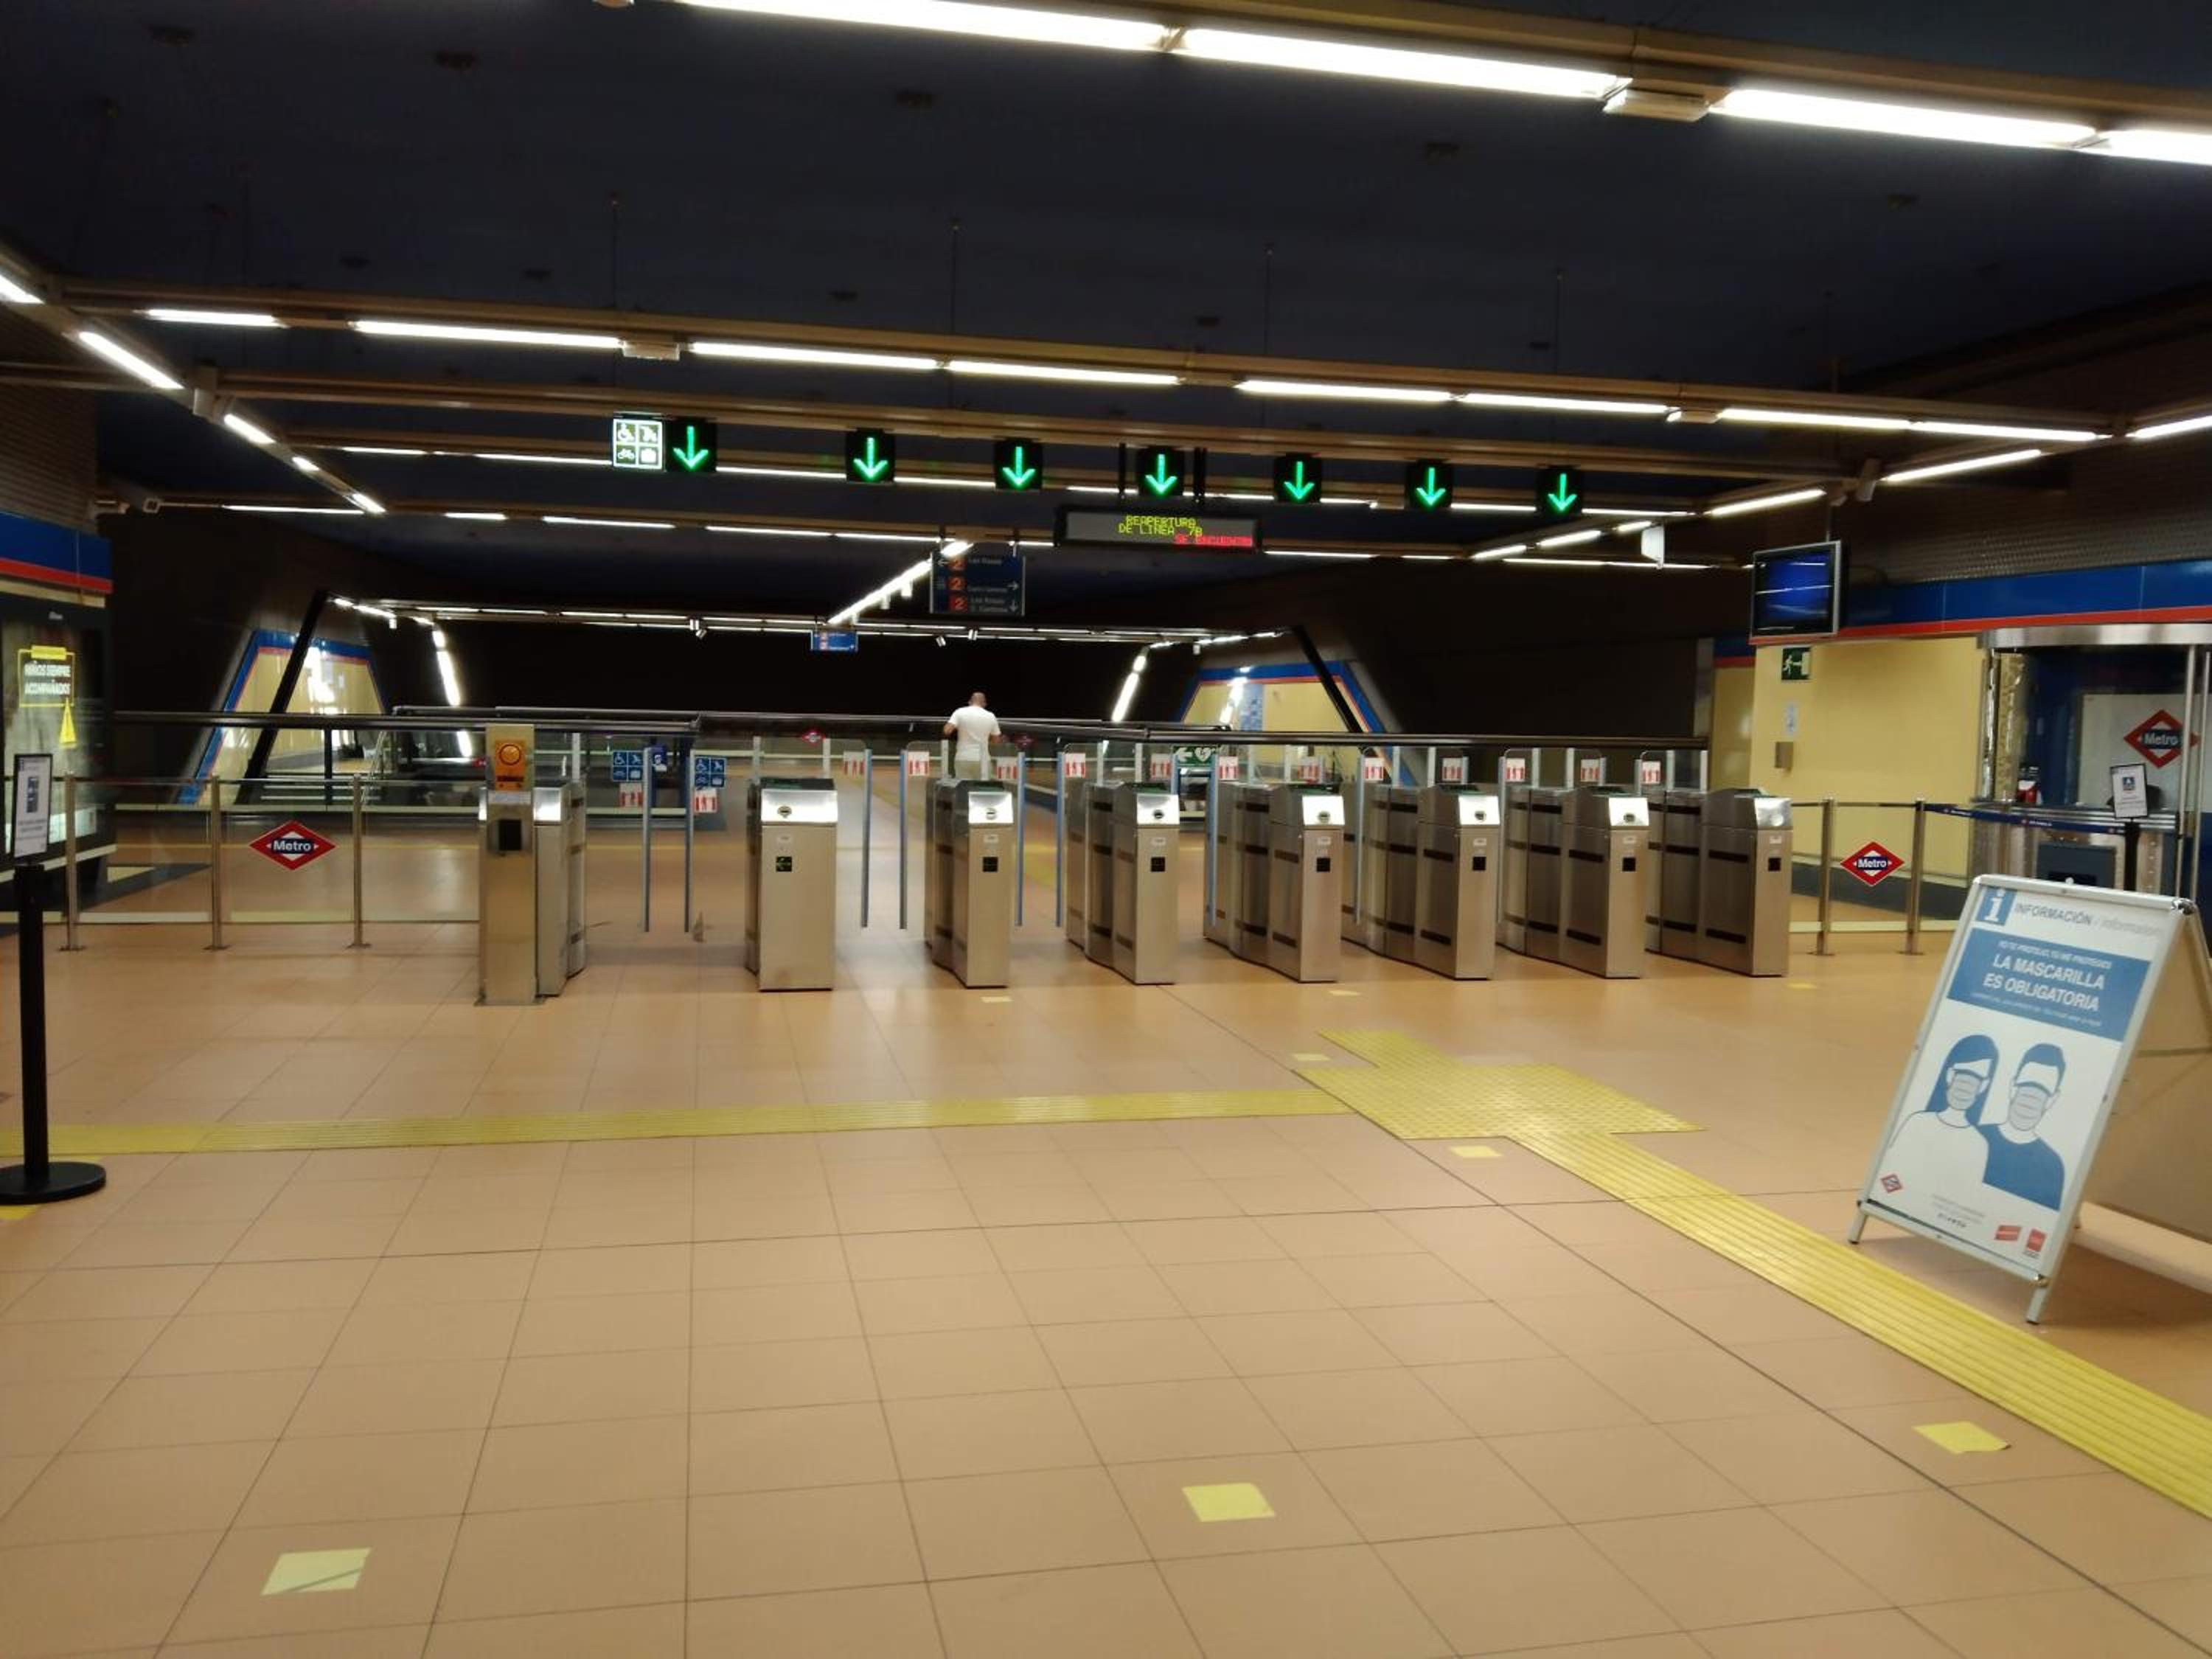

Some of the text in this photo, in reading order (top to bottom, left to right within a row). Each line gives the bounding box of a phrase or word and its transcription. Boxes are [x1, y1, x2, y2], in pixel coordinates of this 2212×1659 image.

[1119, 522, 1133, 534] DE
[1139, 524, 1175, 536] LINEA
[2143, 732, 2179, 745] Metro
[273, 840, 312, 852] Metro
[1857, 858, 1887, 868] Metro
[2014, 903, 2091, 925] INFORMACIÓN
[1992, 953, 2011, 970] LA
[2012, 957, 2105, 990] MASCARILLA
[1983, 973, 2003, 990] ES
[2004, 977, 2100, 1012] OBLIGATORIA
